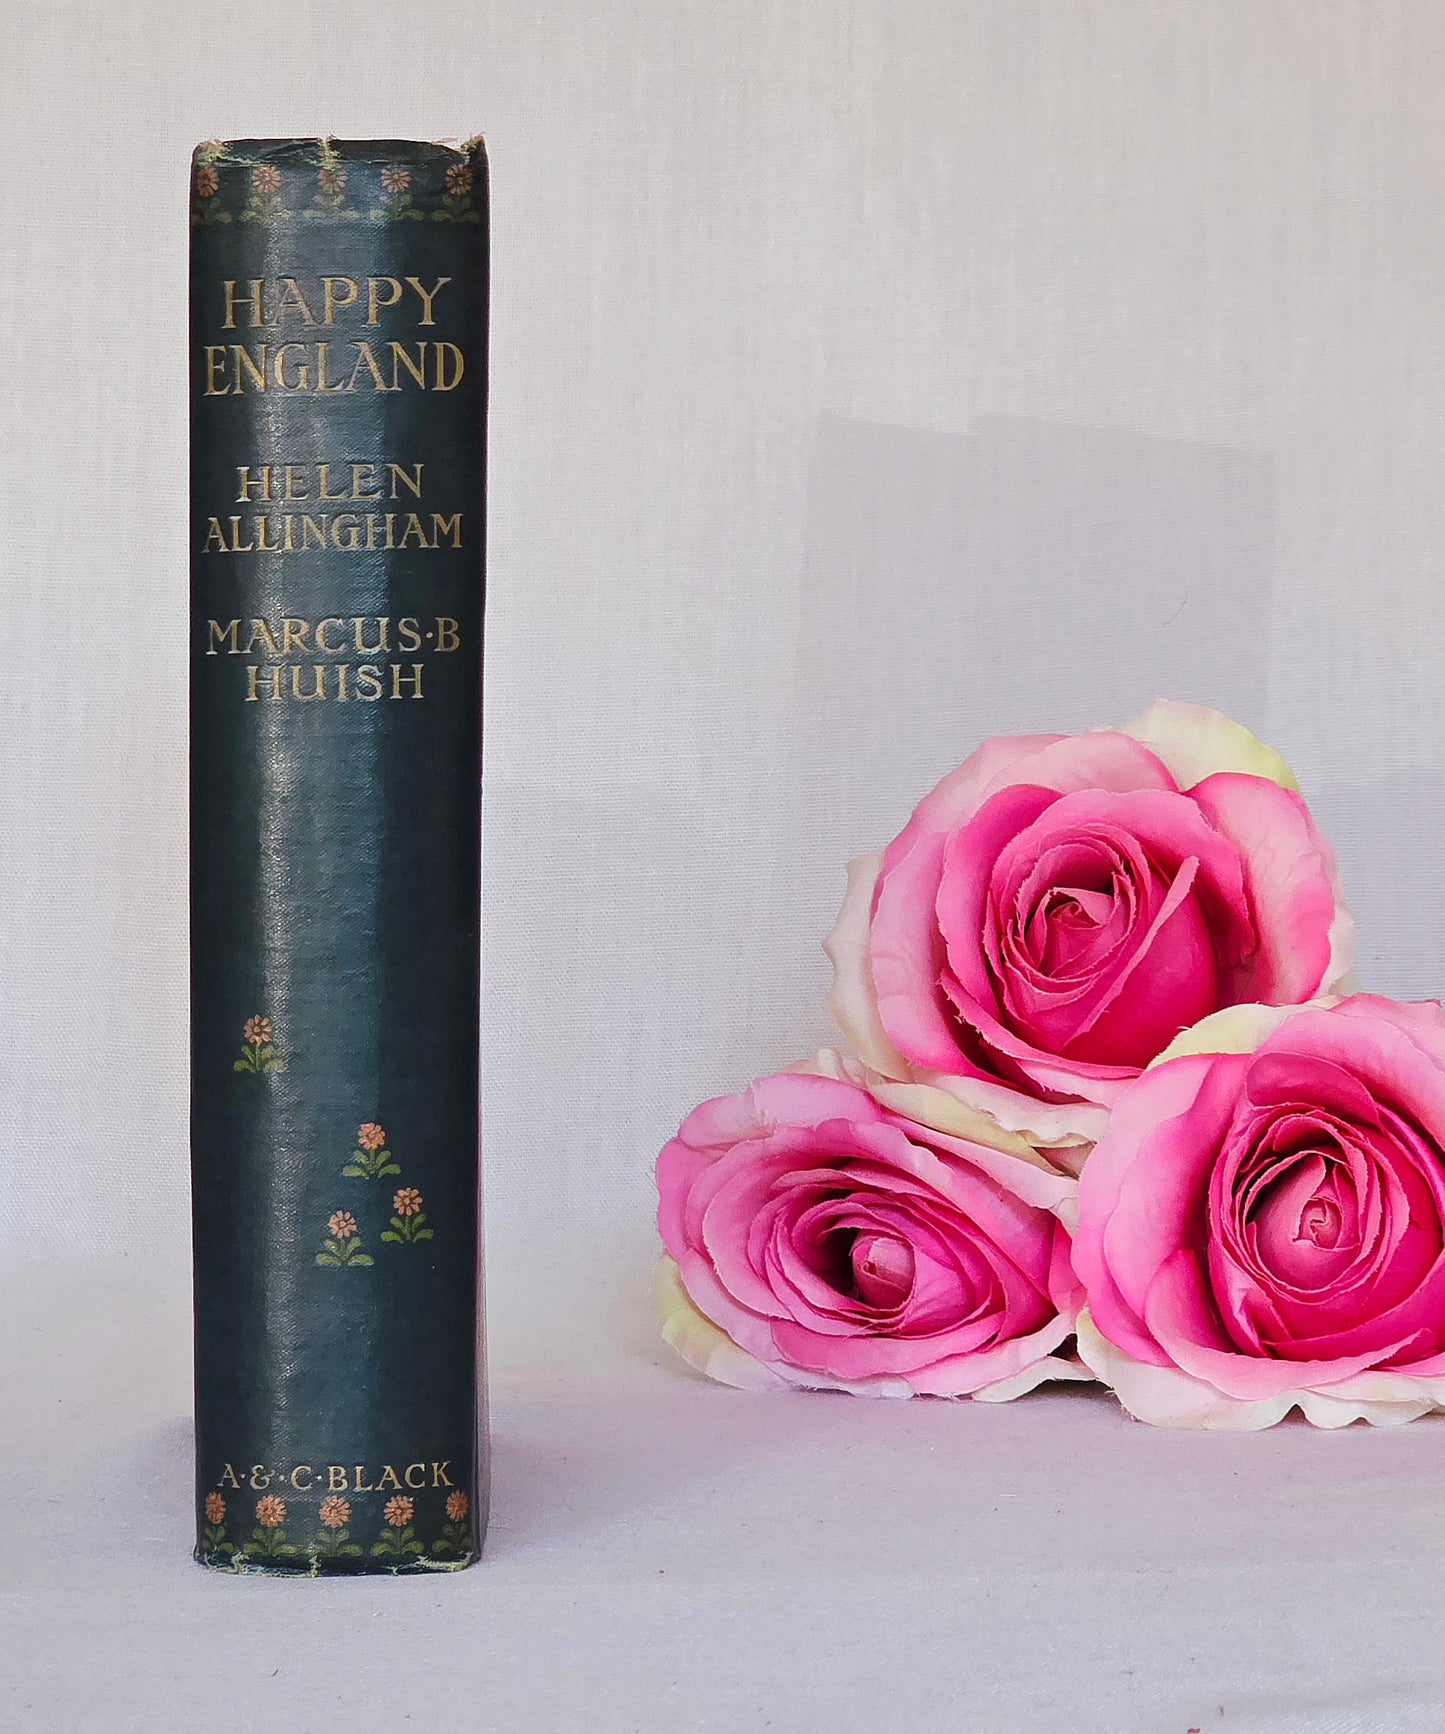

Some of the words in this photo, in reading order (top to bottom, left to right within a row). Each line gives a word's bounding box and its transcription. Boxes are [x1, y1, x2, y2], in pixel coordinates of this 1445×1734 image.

[221, 277, 452, 328] HAPPY
[203, 341, 465, 397] ENGLAND
[235, 463, 424, 503] HELEN
[202, 513, 464, 552] ALLINGHAM
[244, 663, 424, 701] HUISH
